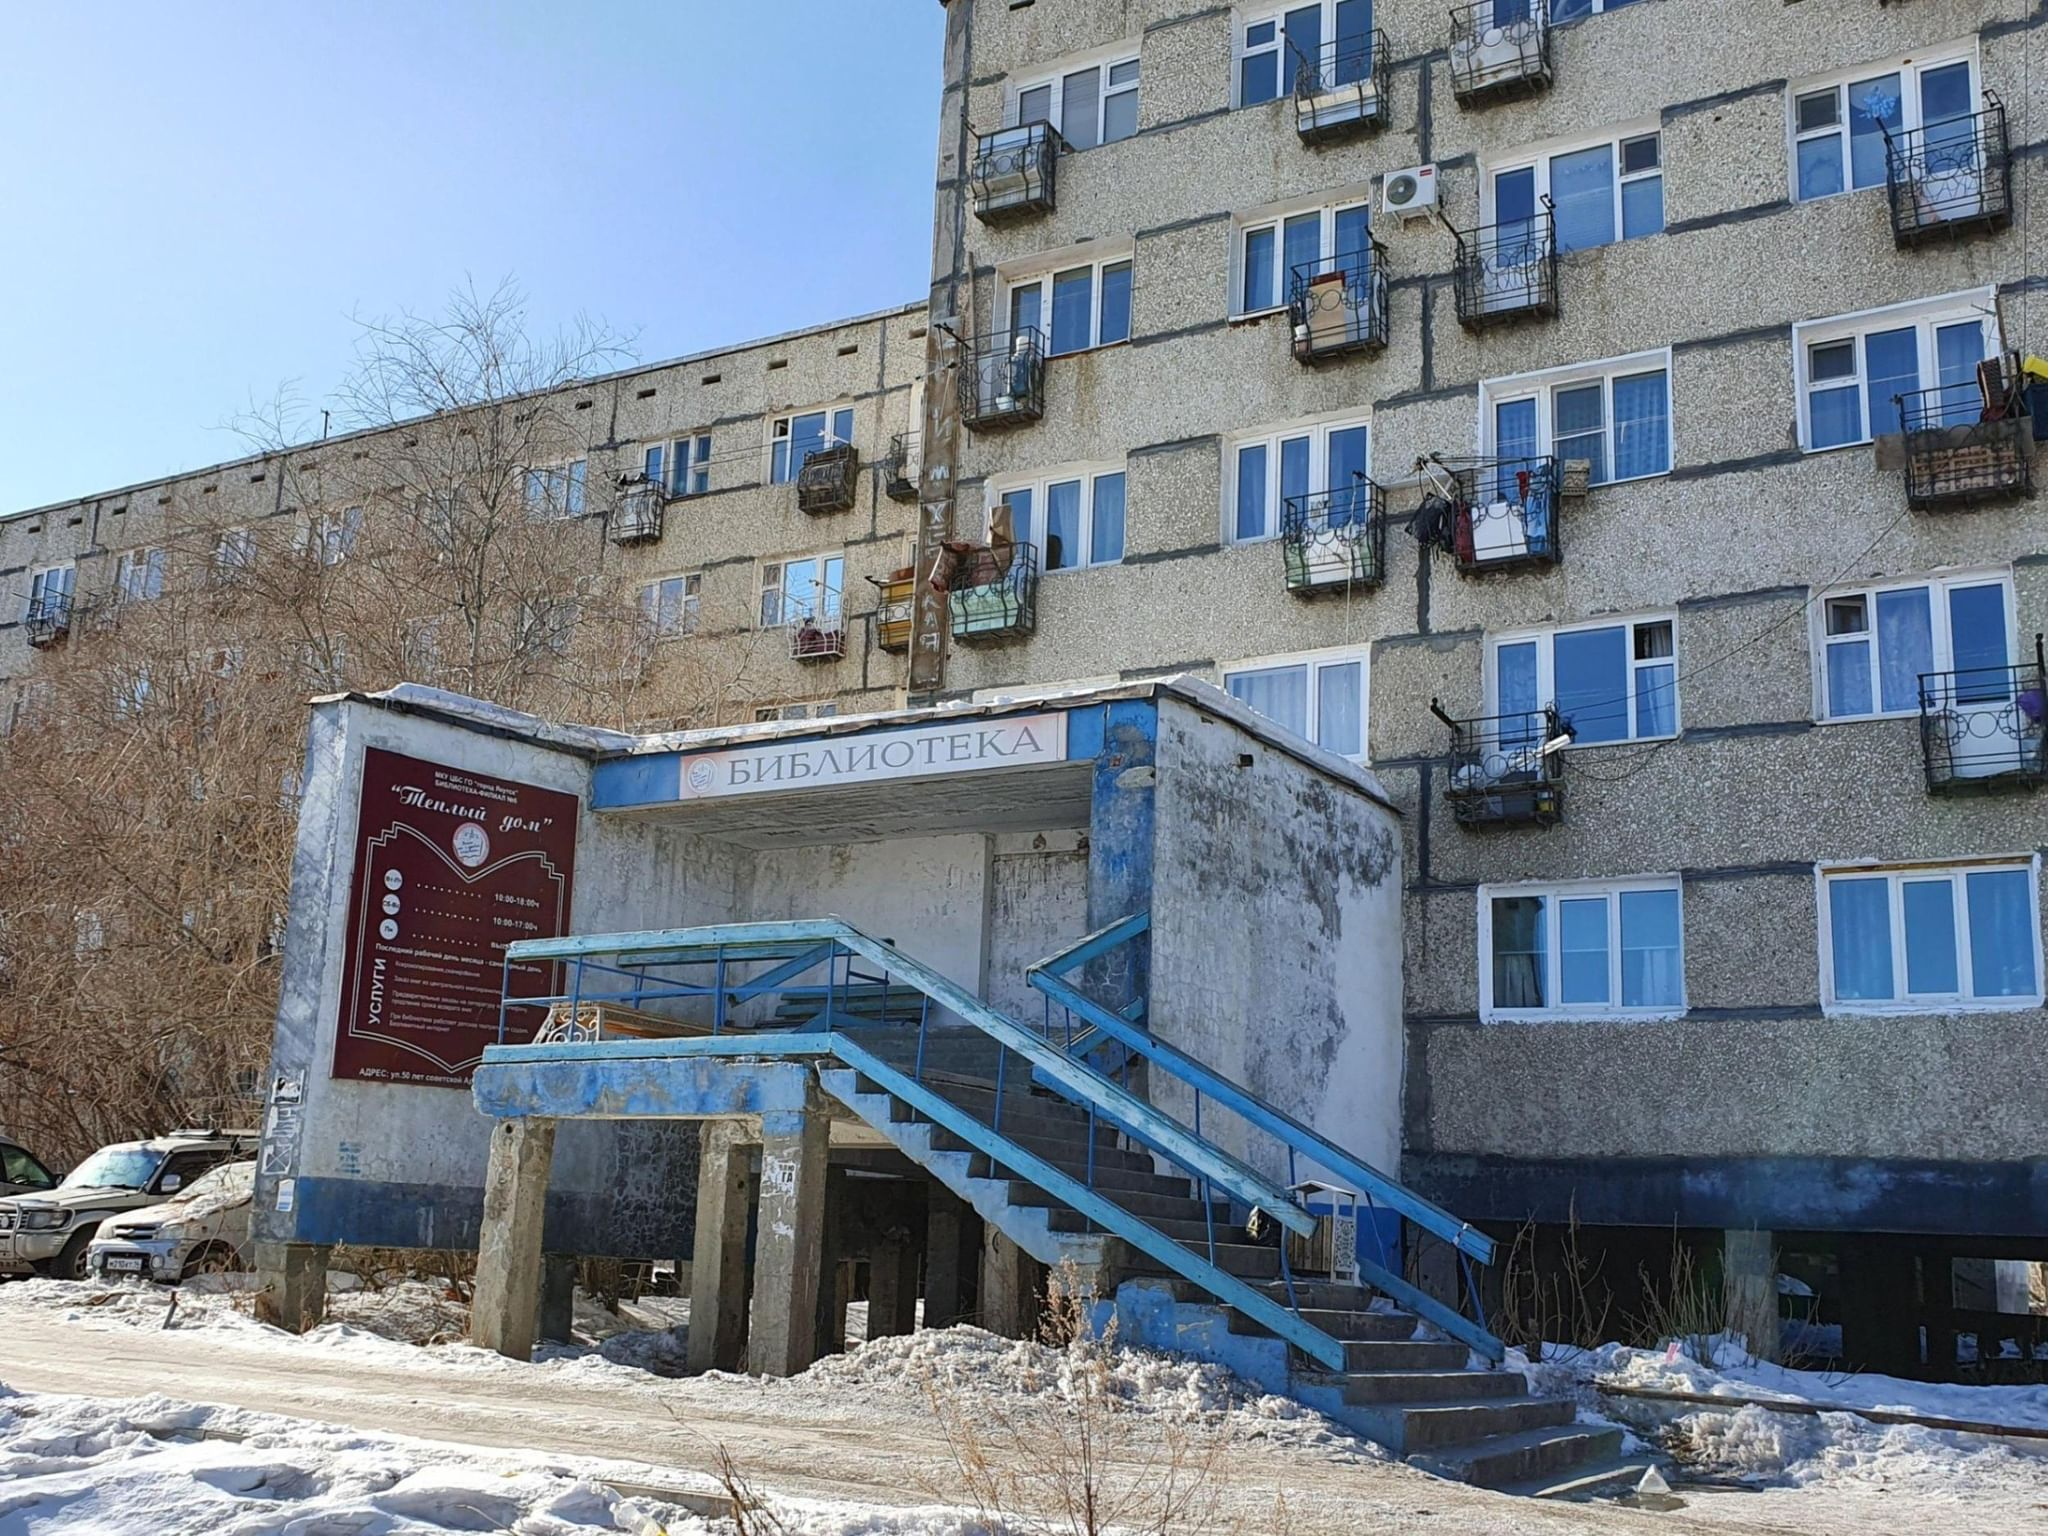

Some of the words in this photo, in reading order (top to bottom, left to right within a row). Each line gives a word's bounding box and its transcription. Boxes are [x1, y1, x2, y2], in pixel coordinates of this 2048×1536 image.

[727, 725, 1044, 786] БИБЛИОТЕКА
[368, 958, 387, 1025] УСЛУГИ
[359, 1067, 389, 1078] АДРЕС:
